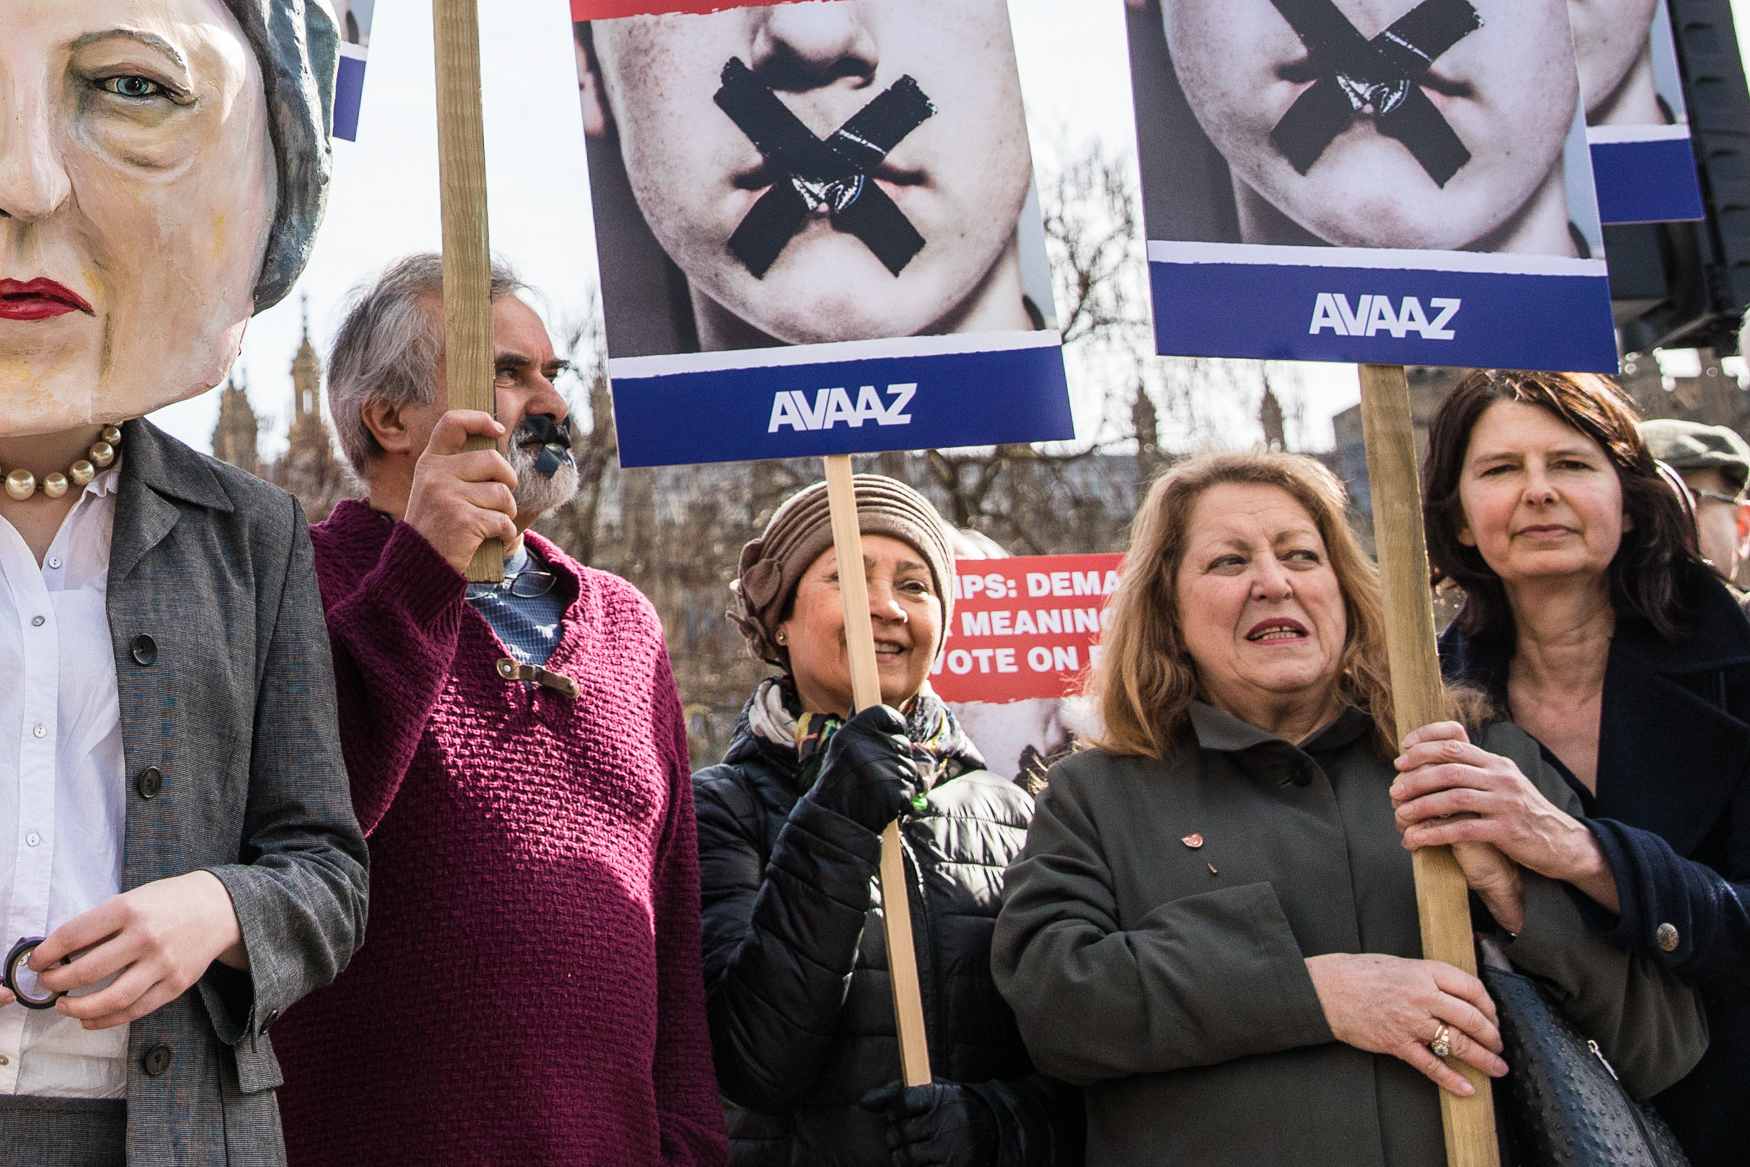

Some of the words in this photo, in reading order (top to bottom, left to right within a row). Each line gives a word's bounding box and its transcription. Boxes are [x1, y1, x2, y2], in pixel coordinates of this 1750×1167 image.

[1309, 292, 1461, 340] AVAAZ
[768, 383, 918, 433] AVAAZ
[1026, 570, 1121, 598] DEMA
[961, 607, 1116, 637] MEANIN
[1027, 645, 1080, 673] ON
